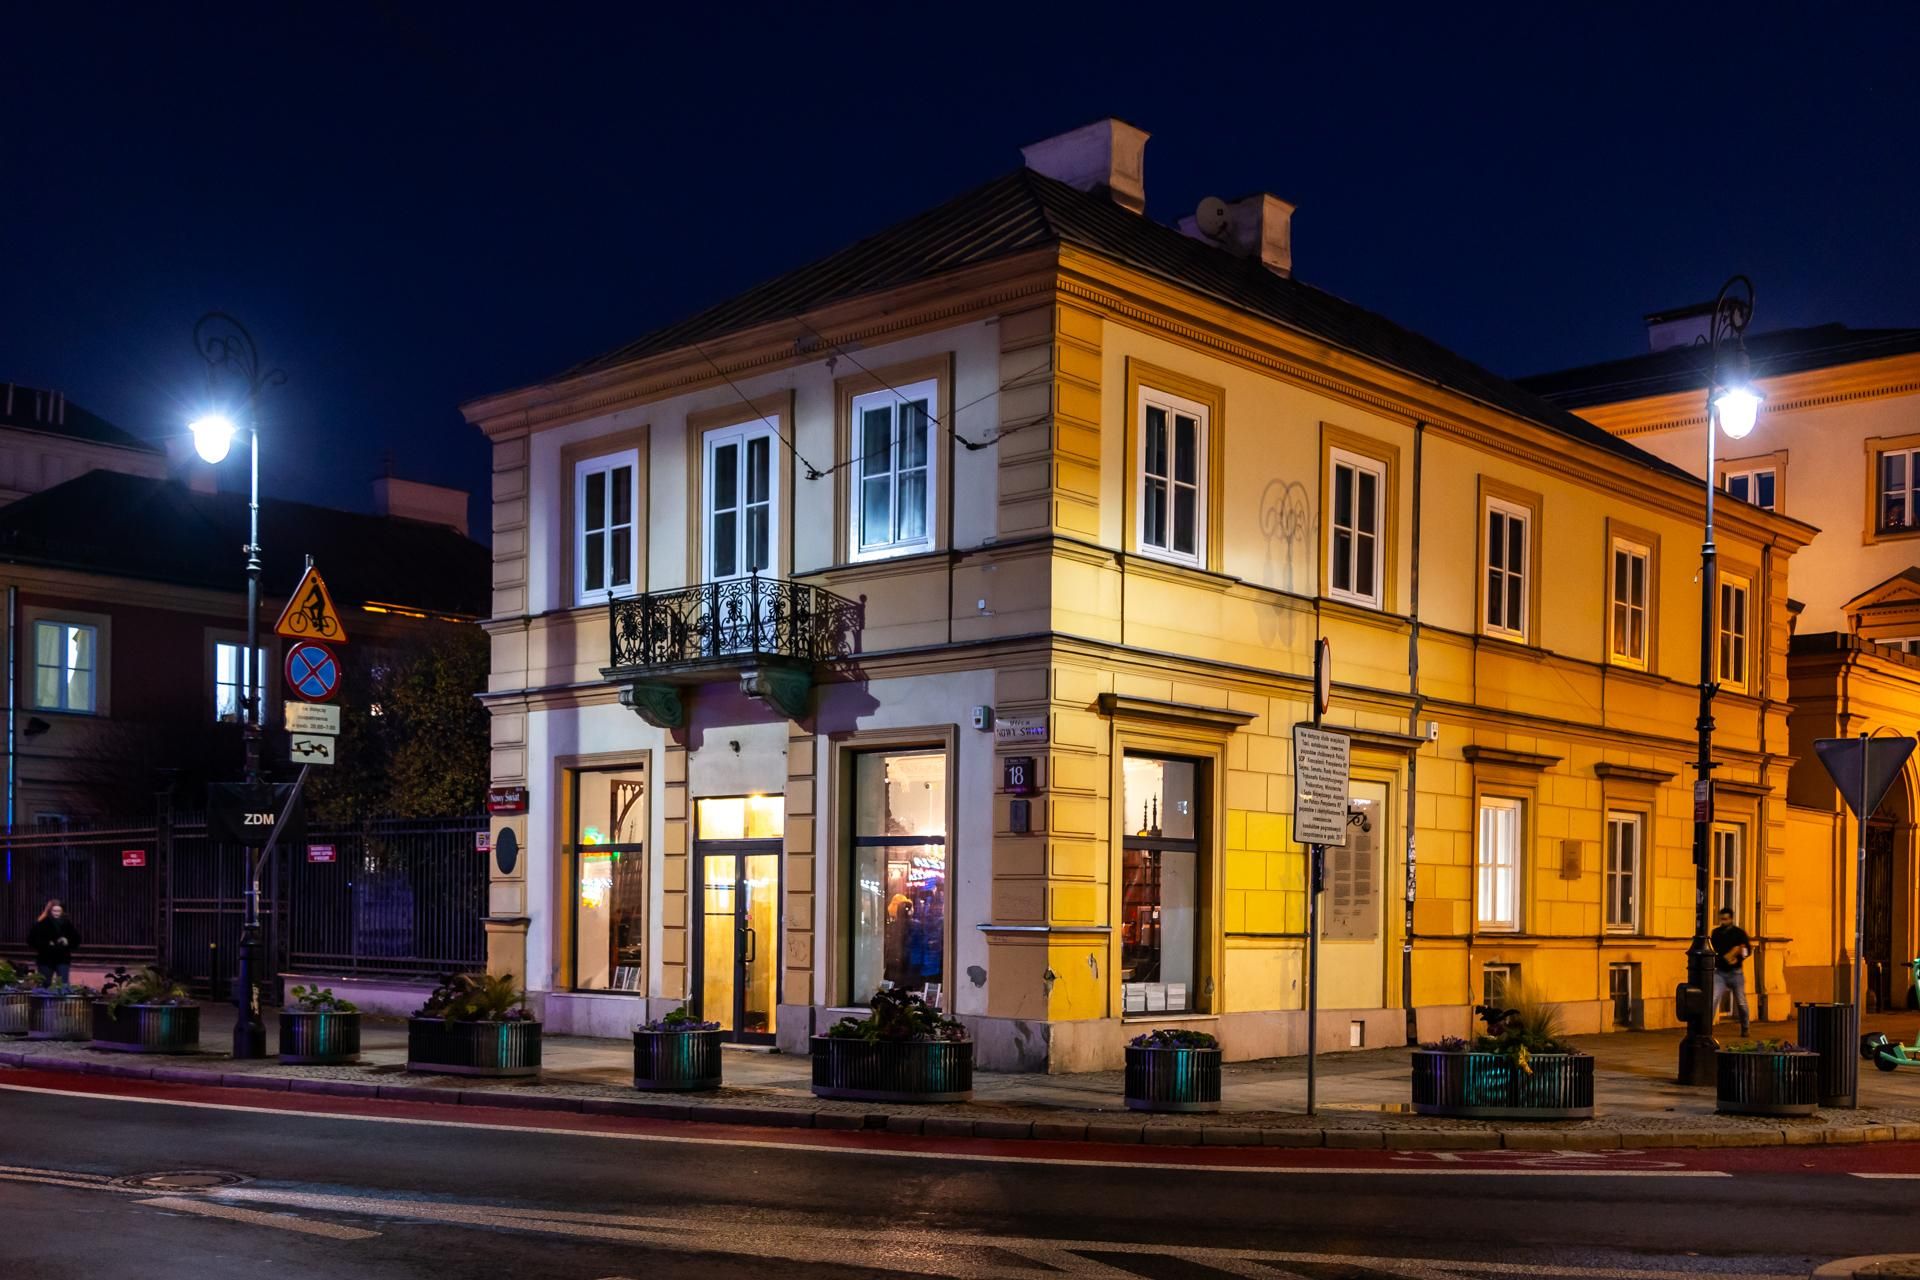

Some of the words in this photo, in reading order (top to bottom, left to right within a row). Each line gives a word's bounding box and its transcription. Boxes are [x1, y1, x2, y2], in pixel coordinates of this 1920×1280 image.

[1009, 766, 1024, 785] 18
[504, 790, 520, 802] Świat
[244, 813, 275, 825] ZDM
